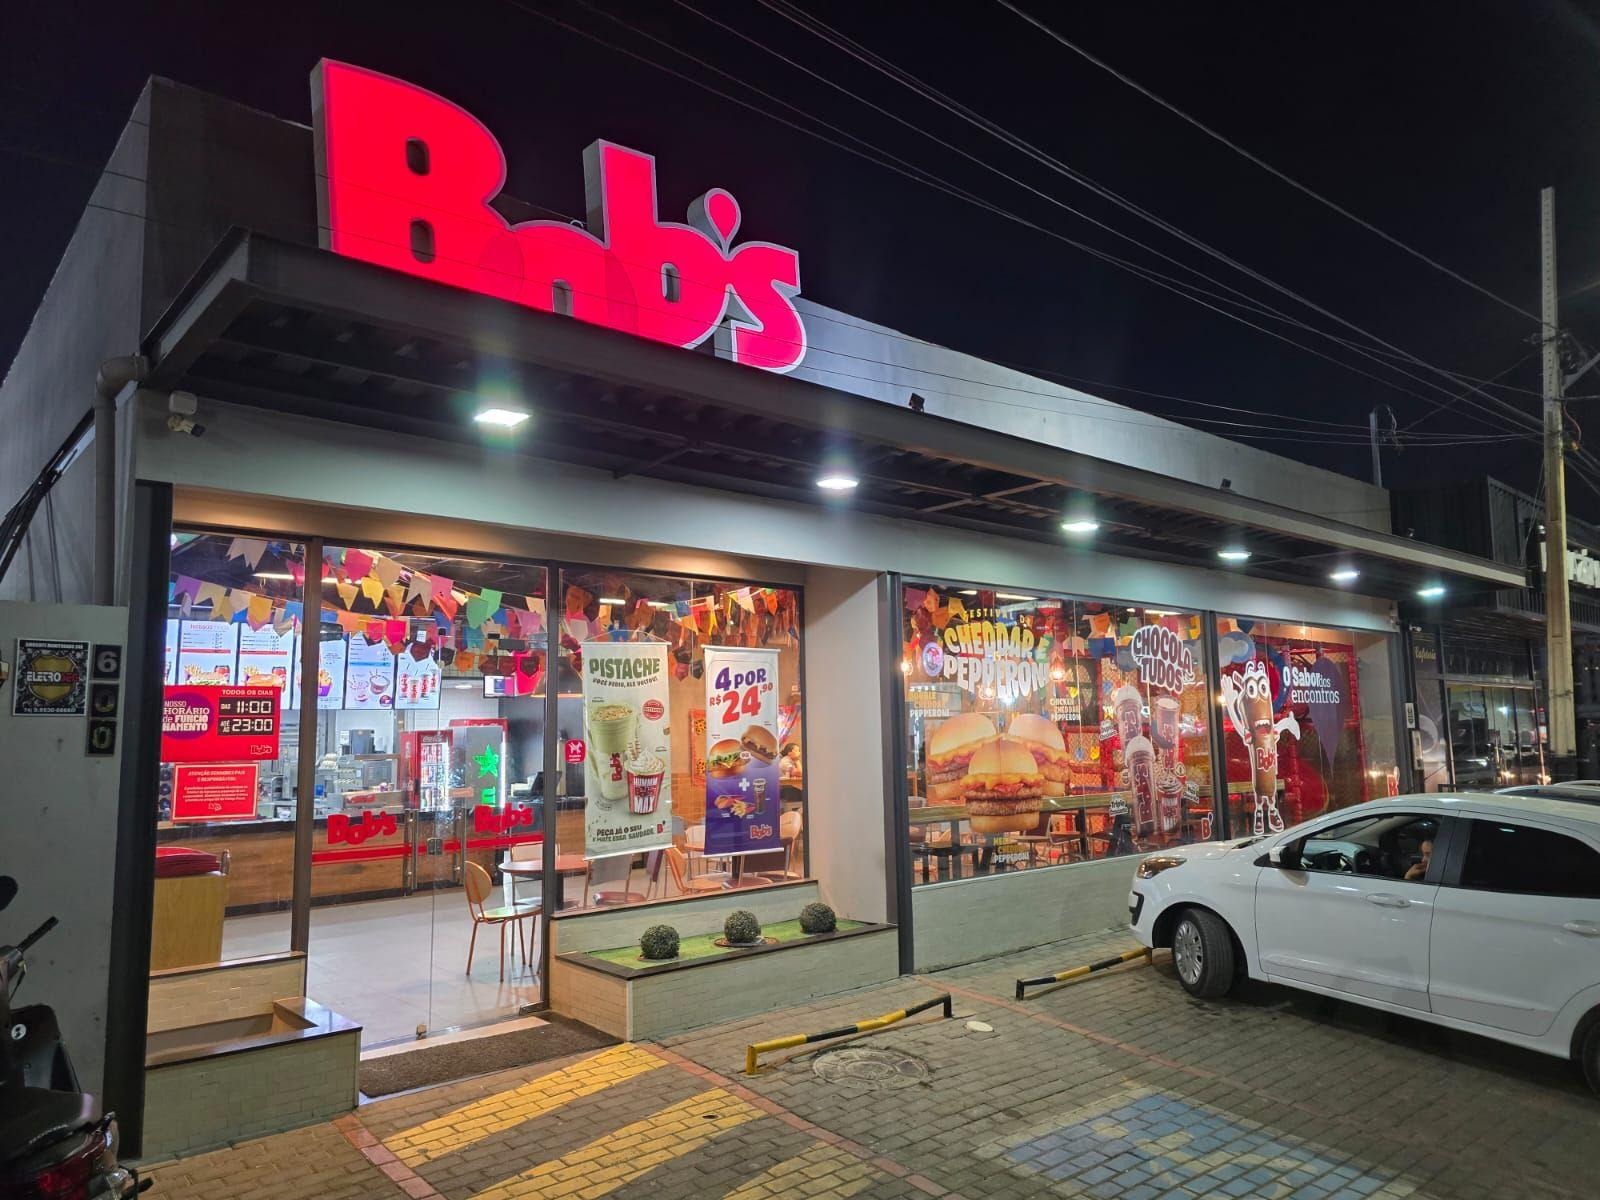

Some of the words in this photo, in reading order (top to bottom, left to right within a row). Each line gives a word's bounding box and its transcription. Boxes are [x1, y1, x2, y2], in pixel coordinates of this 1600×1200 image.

[313, 57, 807, 374] Bob's
[944, 620, 1034, 658] CHEDDAR
[1132, 625, 1193, 674] CHOCOLA
[589, 657, 661, 679] PISTACHE
[714, 666, 731, 691] 4
[734, 668, 767, 689] POR
[1141, 657, 1183, 694] TUDOS
[1282, 666, 1291, 687] O
[1292, 667, 1320, 687] Sabor
[1319, 674, 1331, 688] dos
[236, 700, 272, 714] 11:00
[1291, 688, 1340, 704] encontros
[163, 706, 210, 715] HORÁRIO
[174, 714, 209, 723] FUNCIO
[162, 722, 208, 732] NAMENTO
[232, 718, 273, 732] 23:00
[328, 811, 397, 845] Bob's
[596, 828, 614, 837] PEÇA
